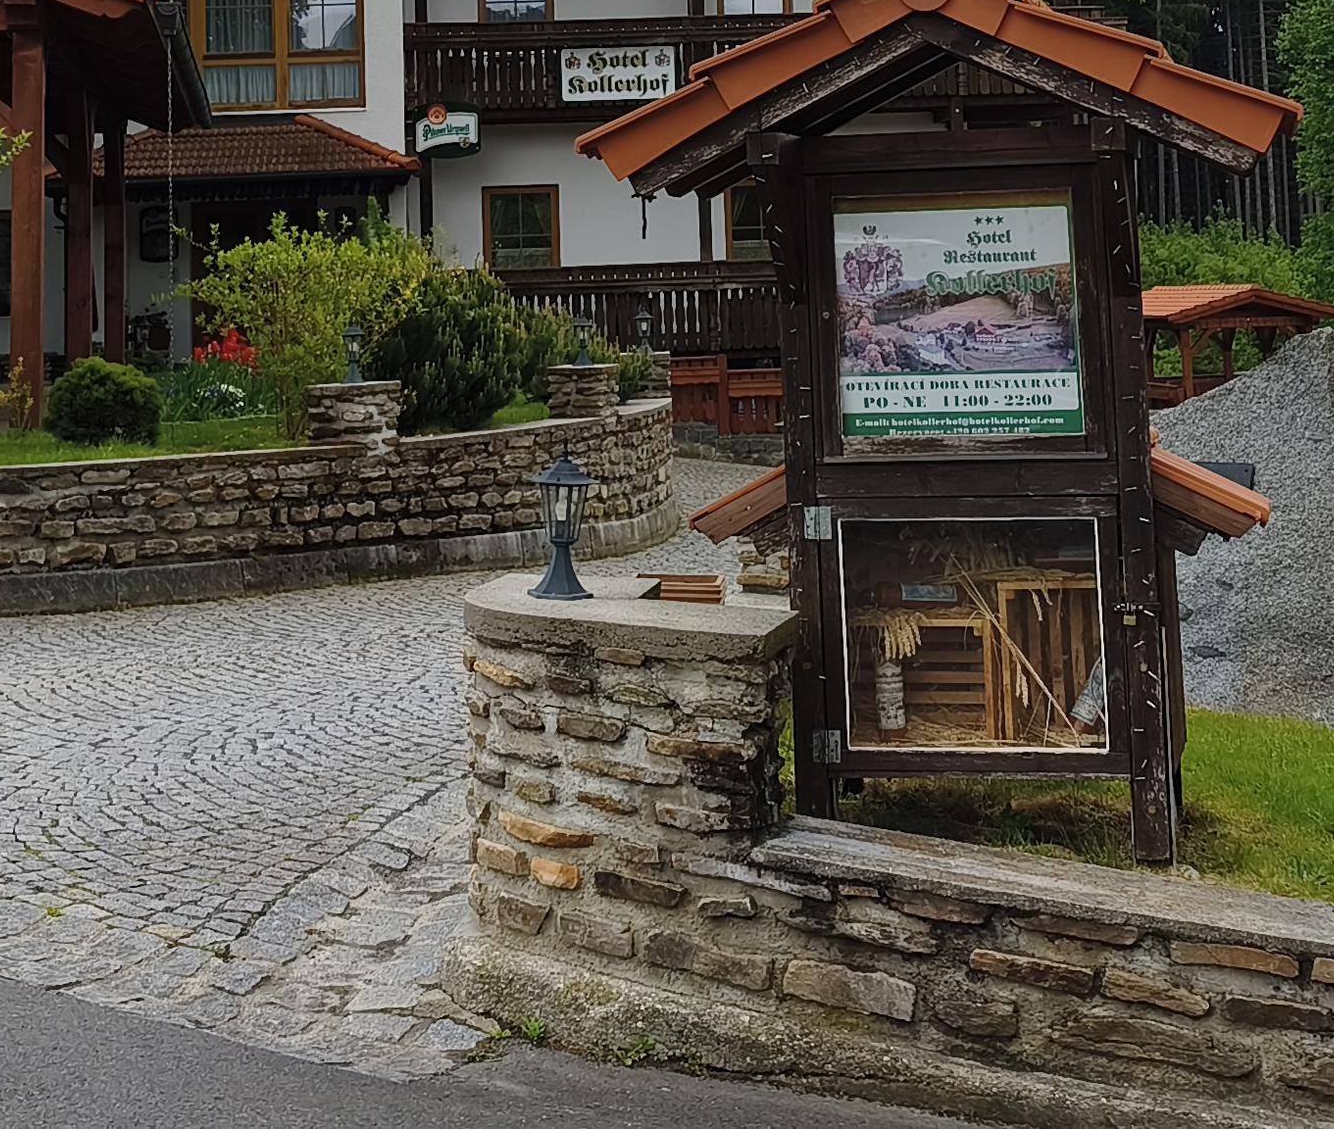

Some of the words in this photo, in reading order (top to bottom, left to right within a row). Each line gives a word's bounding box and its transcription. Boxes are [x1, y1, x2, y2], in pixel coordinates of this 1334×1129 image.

[587, 50, 649, 74] Hotel
[568, 73, 669, 97] Kollerhof
[967, 230, 1012, 248] Hotel
[943, 249, 1037, 264] Restaurant
[925, 270, 1057, 300] Kollerhof
[845, 379, 925, 392] OTEVÍRACÍ
[930, 380, 969, 390] DOBA
[974, 378, 1071, 389] RESTAURACE
[863, 397, 888, 409] PO
[903, 396, 927, 409] NE
[944, 394, 989, 408] 11:00
[1004, 393, 1052, 406] 22:00
